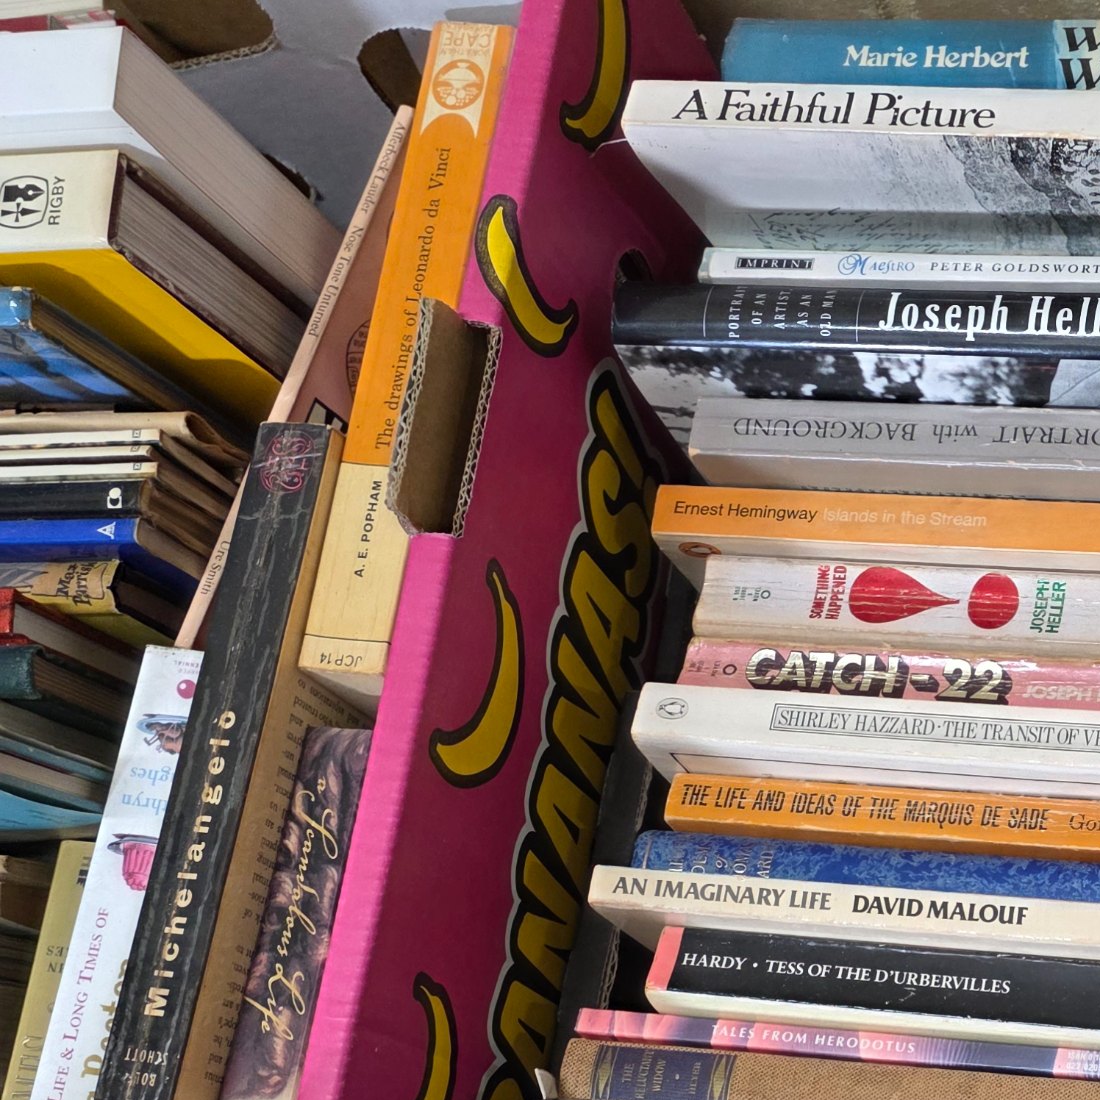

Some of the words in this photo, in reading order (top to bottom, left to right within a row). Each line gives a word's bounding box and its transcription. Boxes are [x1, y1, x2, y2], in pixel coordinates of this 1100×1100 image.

[844, 45, 918, 68] Marie
[923, 45, 1029, 69] Herbert
[672, 88, 709, 121] A
[717, 89, 856, 125] Faithful
[863, 92, 997, 129] Picture
[429, 147, 451, 190] Vinci
[48, 175, 65, 226] RIGBY
[362, 176, 385, 214] Lauder
[425, 199, 440, 218] da
[344, 226, 364, 252] Nose
[332, 255, 350, 282] Tone
[406, 225, 435, 303] Leonardo
[930, 261, 985, 273] PETER
[309, 284, 339, 338] Unturned
[406, 309, 417, 326] of
[878, 292, 1009, 341] Joseph
[385, 334, 414, 410] drawings
[375, 418, 395, 450] The
[733, 417, 917, 441] BACKGROUND
[932, 422, 979, 440] with
[361, 480, 382, 543] POPHAM
[354, 563, 364, 578] A.
[358, 549, 368, 559] E.
[144, 709, 237, 1018] Michelangelo
[277, 790, 338, 957] Scandalous
[96, 906, 109, 928] OF
[612, 877, 647, 895] AN
[654, 879, 785, 908] IMAGINARY
[790, 891, 832, 910] LIFE
[852, 895, 923, 917] DAVID
[927, 898, 1029, 926] MALOUF
[77, 933, 102, 986] TIMES
[682, 953, 748, 970] HARDY
[765, 960, 804, 976] TESS
[807, 964, 832, 978] OF
[834, 966, 871, 981] THE
[874, 970, 1011, 994] D'URBERVILLES
[62, 991, 88, 1043] LONG
[244, 964, 306, 1040] Life
[60, 1047, 74, 1061] &
[711, 1024, 756, 1040] TALES
[762, 1029, 807, 1044] FROM
[815, 1034, 916, 1054] HERODOTUS
